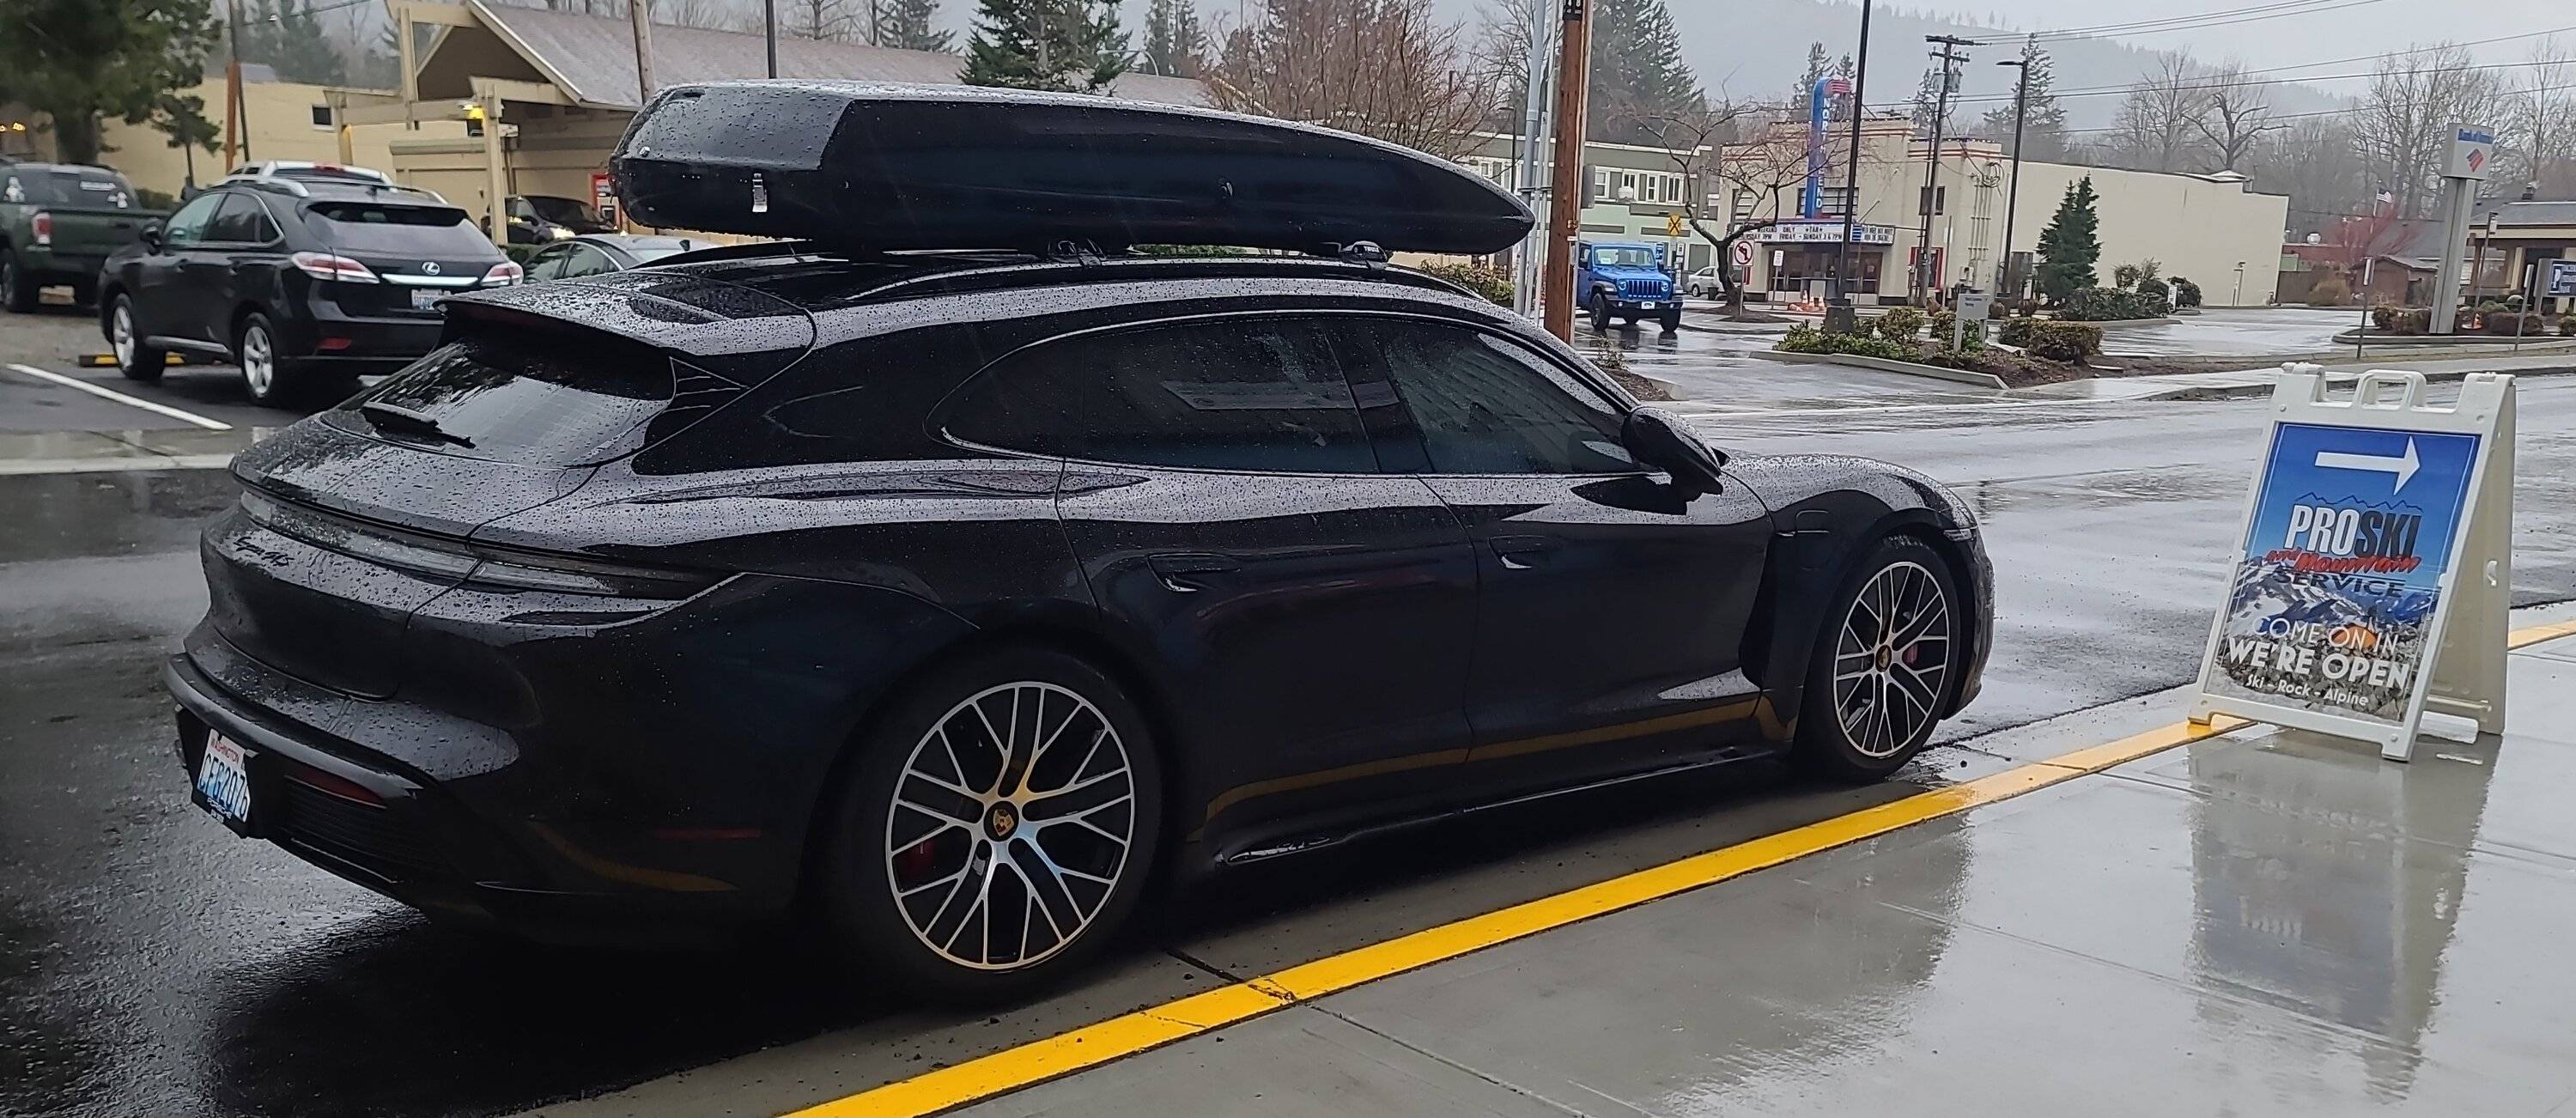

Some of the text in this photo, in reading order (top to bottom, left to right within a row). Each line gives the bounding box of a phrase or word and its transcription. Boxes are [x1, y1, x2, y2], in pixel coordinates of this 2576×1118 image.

[2275, 568, 2406, 598] SERVICE
[2252, 616, 2399, 655] COME ON IN
[2228, 637, 2411, 690] WE'RE OPEN
[2245, 673, 2265, 689] Ski
[2276, 679, 2311, 696] Rock
[2323, 688, 2369, 707] Alpine
[199, 752, 248, 817] CFG2076
